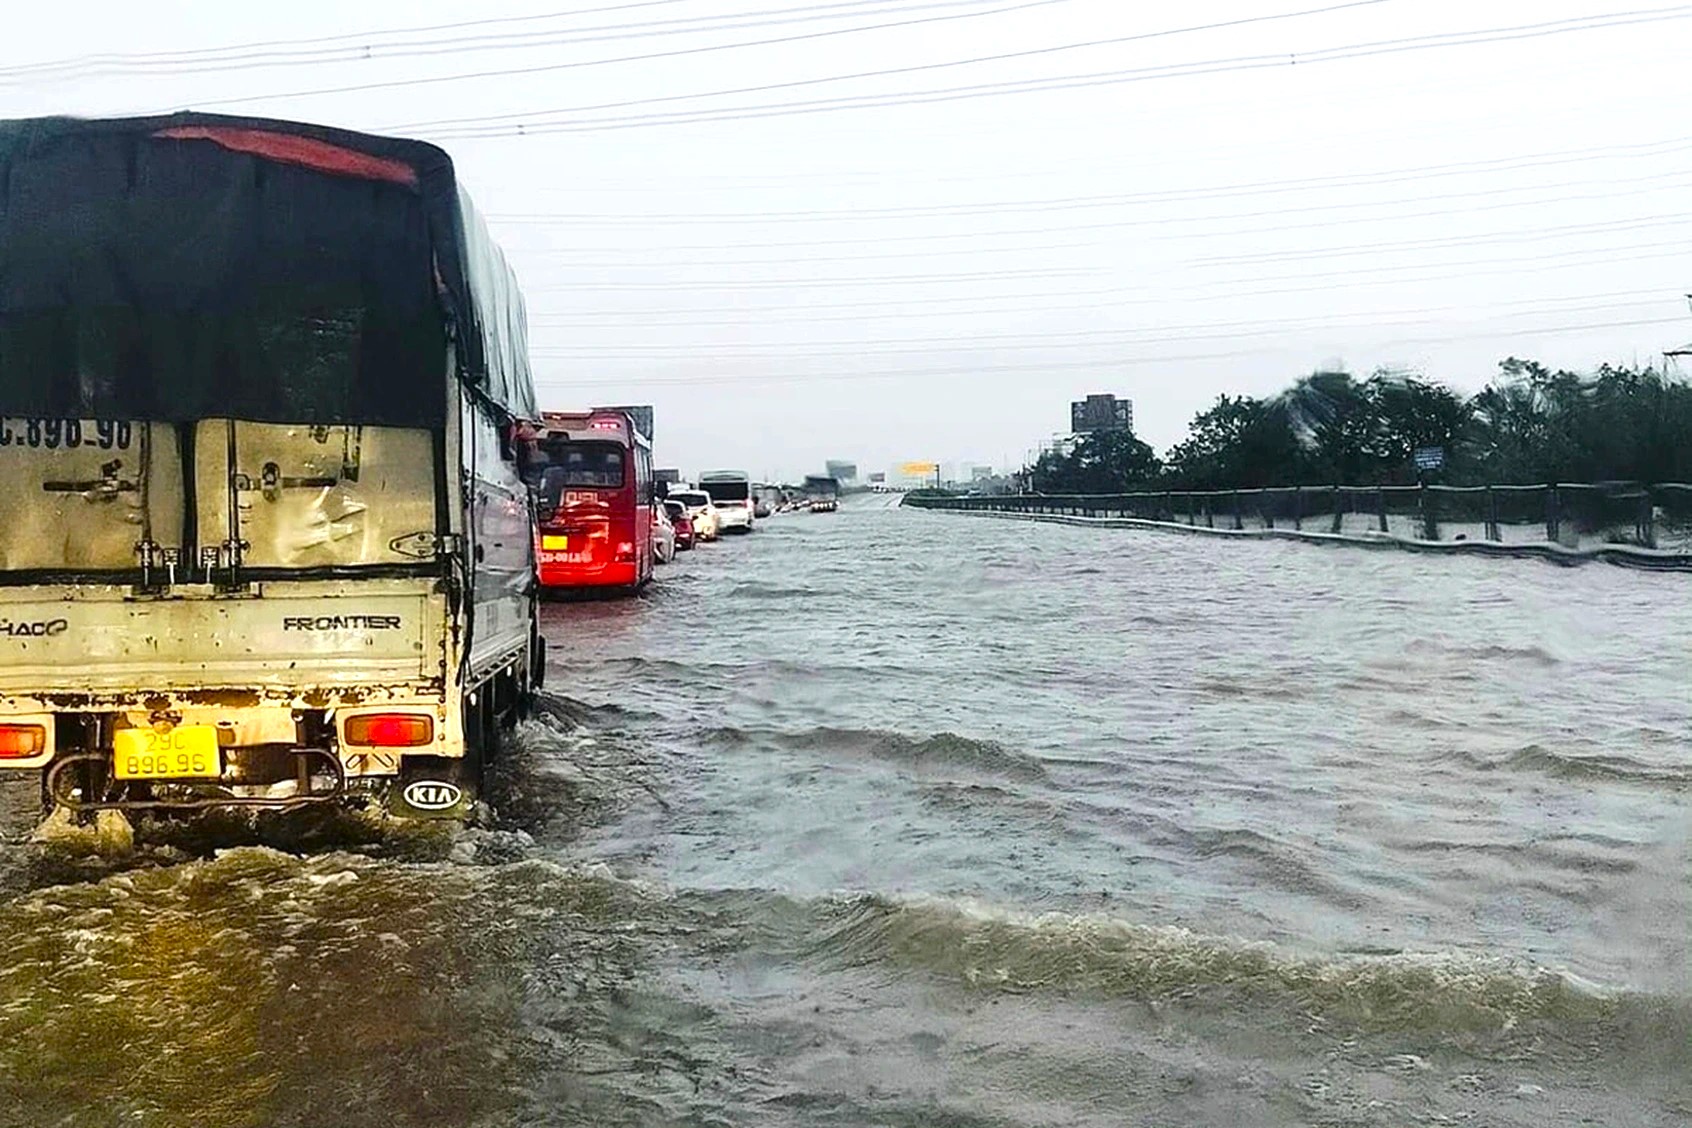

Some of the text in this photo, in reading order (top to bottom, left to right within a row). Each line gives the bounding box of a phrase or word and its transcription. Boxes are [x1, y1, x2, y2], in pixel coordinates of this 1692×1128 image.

[283, 615, 401, 631] FRONTIER
[145, 732, 186, 752] 29C
[412, 786, 452, 803] KIA
